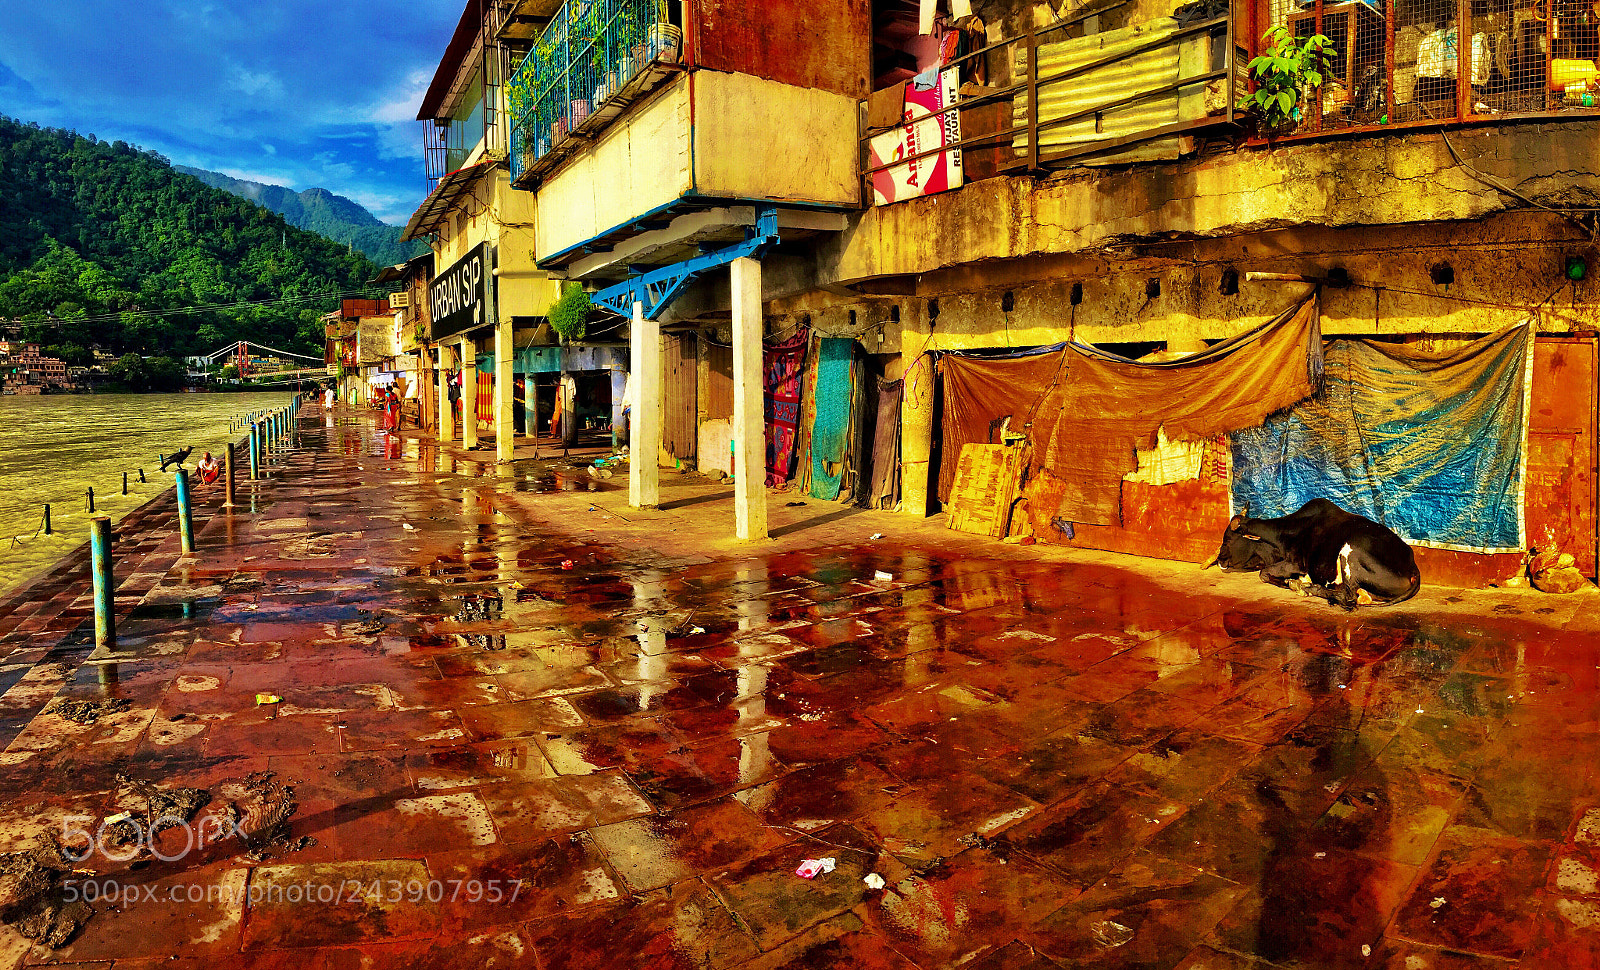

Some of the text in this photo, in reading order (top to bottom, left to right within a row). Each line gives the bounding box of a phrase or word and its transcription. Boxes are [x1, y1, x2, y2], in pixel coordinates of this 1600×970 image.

[902, 108, 919, 188] Ananda
[944, 112, 952, 147] VIJAY
[948, 86, 961, 168] RESTAURNT
[430, 256, 481, 323] URBAN SIP
